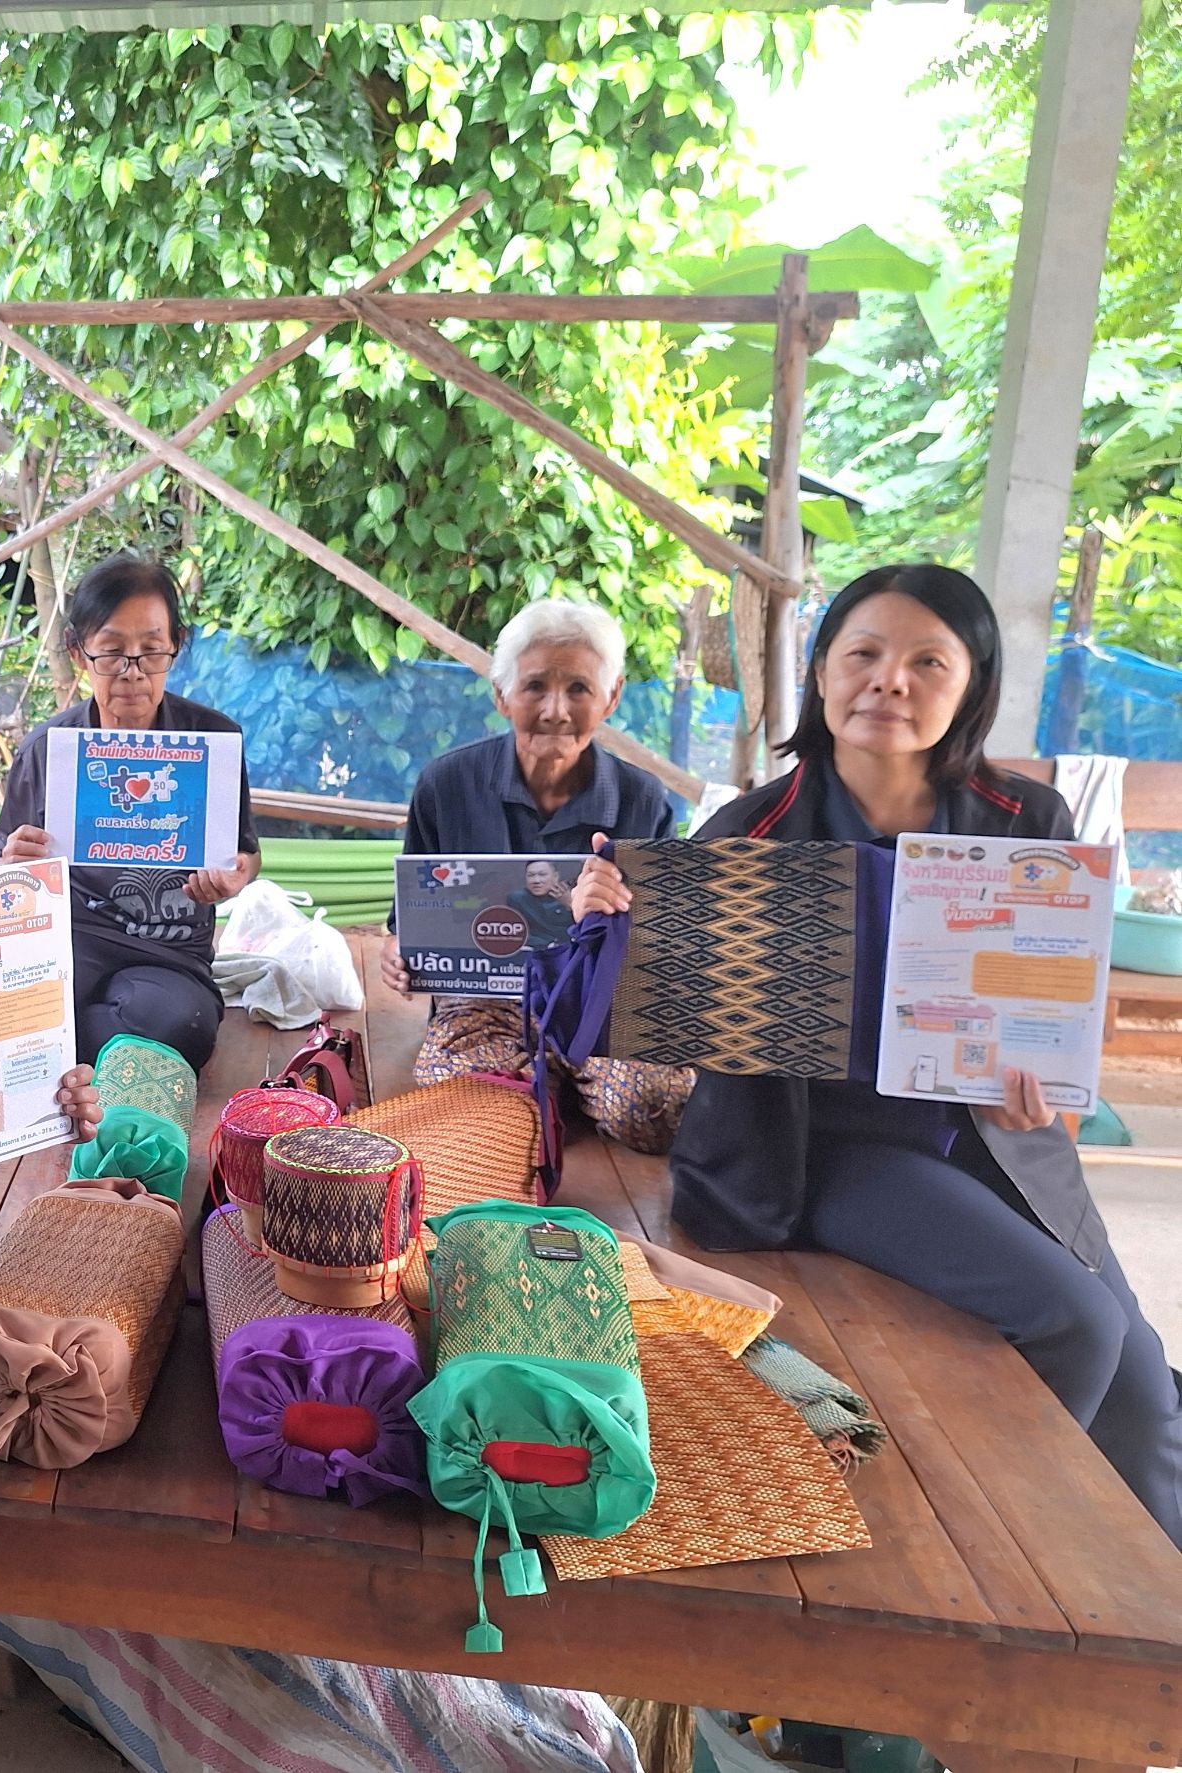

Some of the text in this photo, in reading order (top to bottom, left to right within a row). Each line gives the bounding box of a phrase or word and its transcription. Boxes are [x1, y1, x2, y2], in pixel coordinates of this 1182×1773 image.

[86, 740, 203, 761] ร้านนี้เข้าร่วมโครงการ
[153, 781, 166, 790] 50
[118, 793, 131, 802] 50
[96, 813, 149, 828] คนละครึ่ง
[88, 833, 186, 861] คนละครึ่ง
[26, 916, 49, 929] OTOP
[477, 922, 523, 935] OTOP
[408, 951, 453, 973] ปลัด
[459, 957, 498, 973] มท.
[489, 980, 523, 990] OTOP
